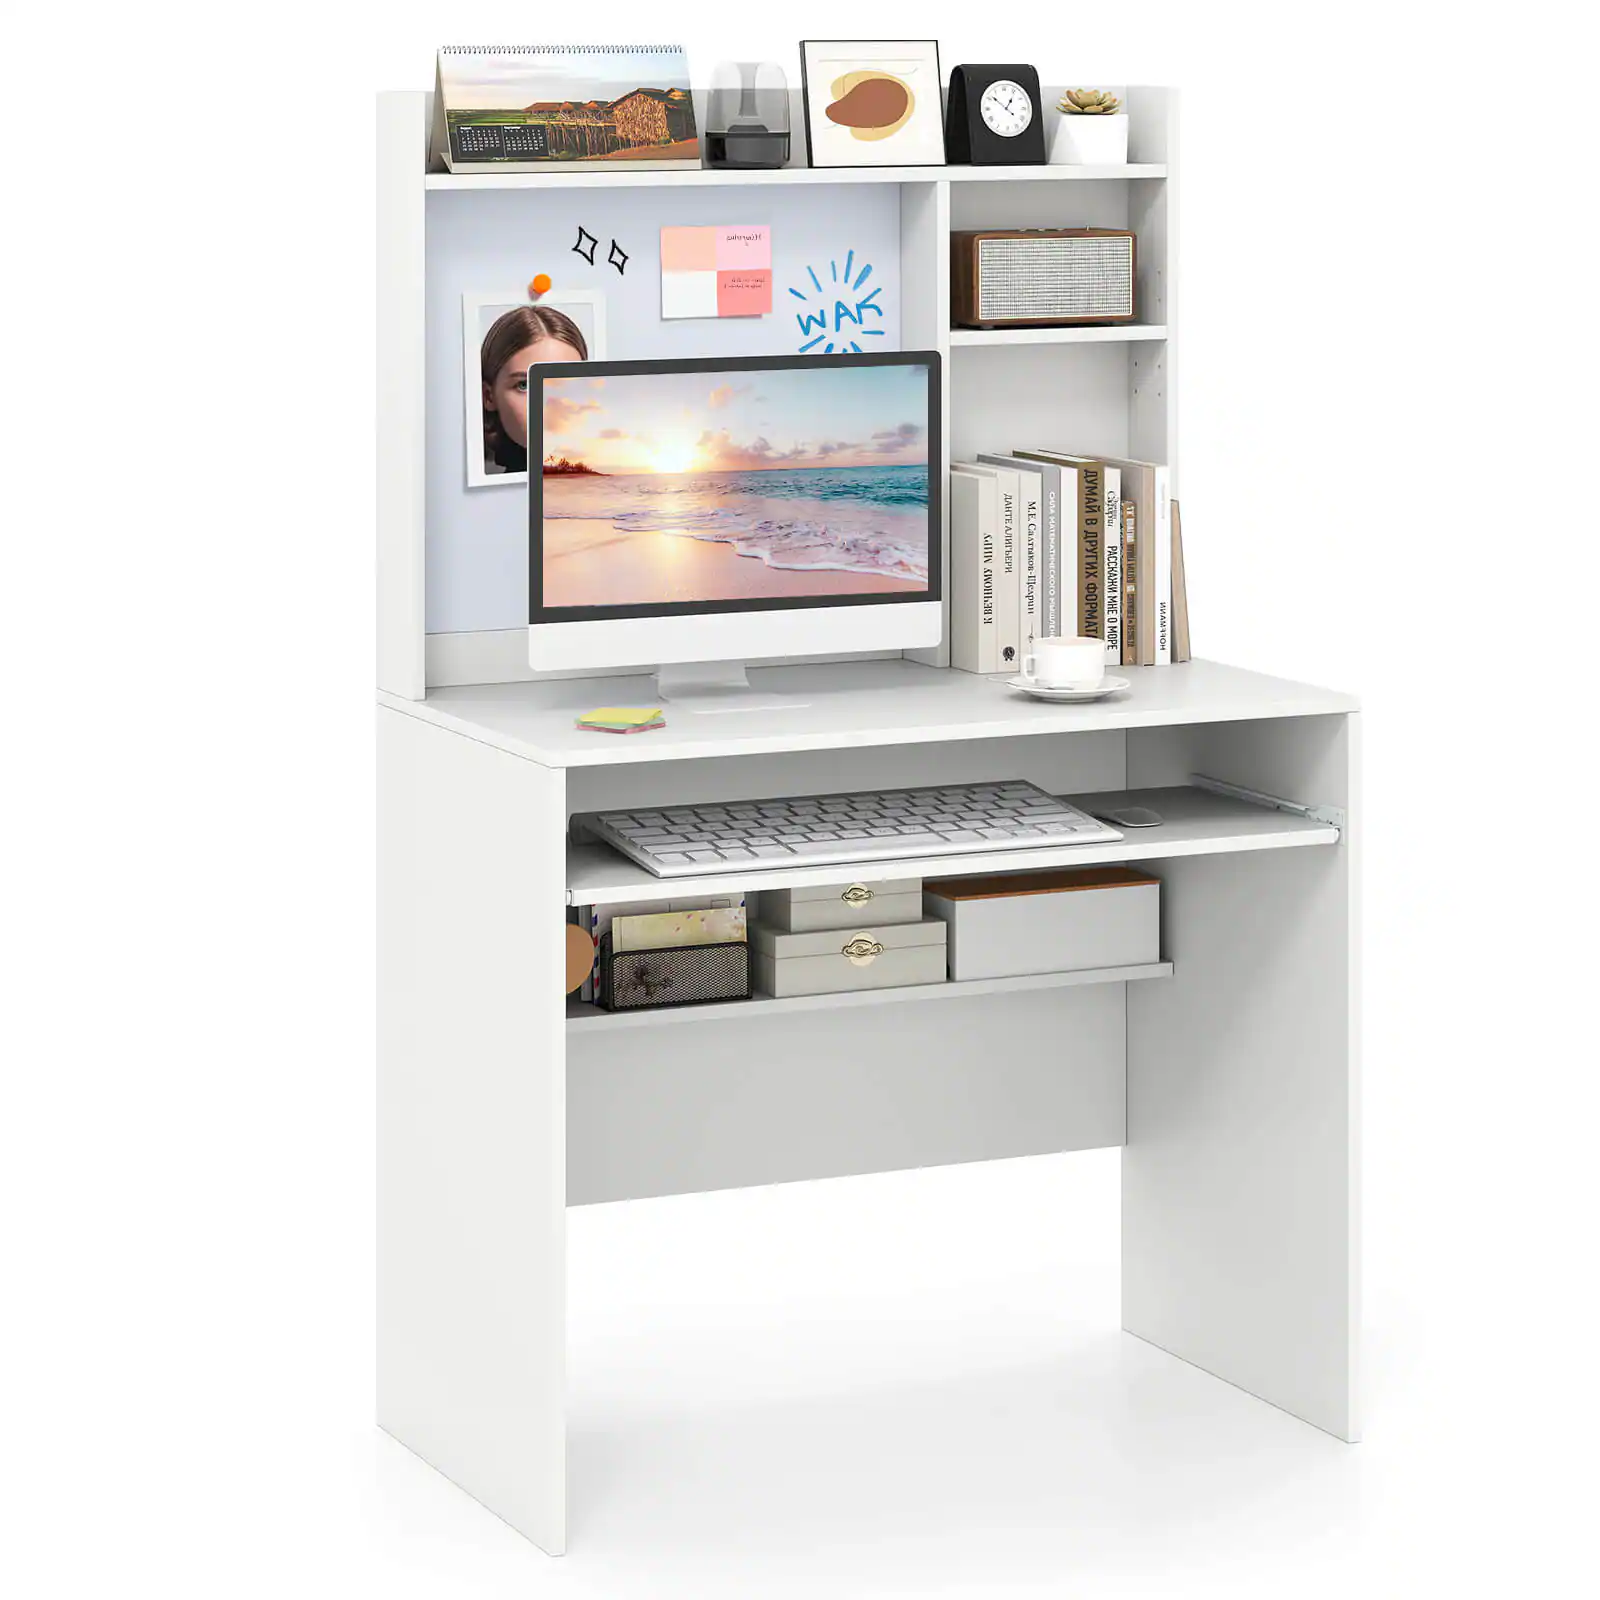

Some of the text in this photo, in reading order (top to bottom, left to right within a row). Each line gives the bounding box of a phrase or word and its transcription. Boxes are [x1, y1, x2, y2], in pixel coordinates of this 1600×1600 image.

[1048, 491, 1057, 514] СИЛА
[1084, 468, 1101, 514] ДУМАЙ
[1003, 493, 1013, 525] ДАНТЕ
[1027, 501, 1037, 522] М.Е.
[1085, 518, 1098, 526] В
[1048, 516, 1057, 596] МАТЕМАТИЧЕСКОГО
[1084, 530, 1098, 579] ДРУГИХ
[1106, 545, 1118, 594] РАССКАЖИ
[983, 532, 993, 625] К ВЕЧНОМУ МИРУ
[1106, 595, 1118, 615] МНЕ
[1106, 625, 1118, 651] МОРЕ
